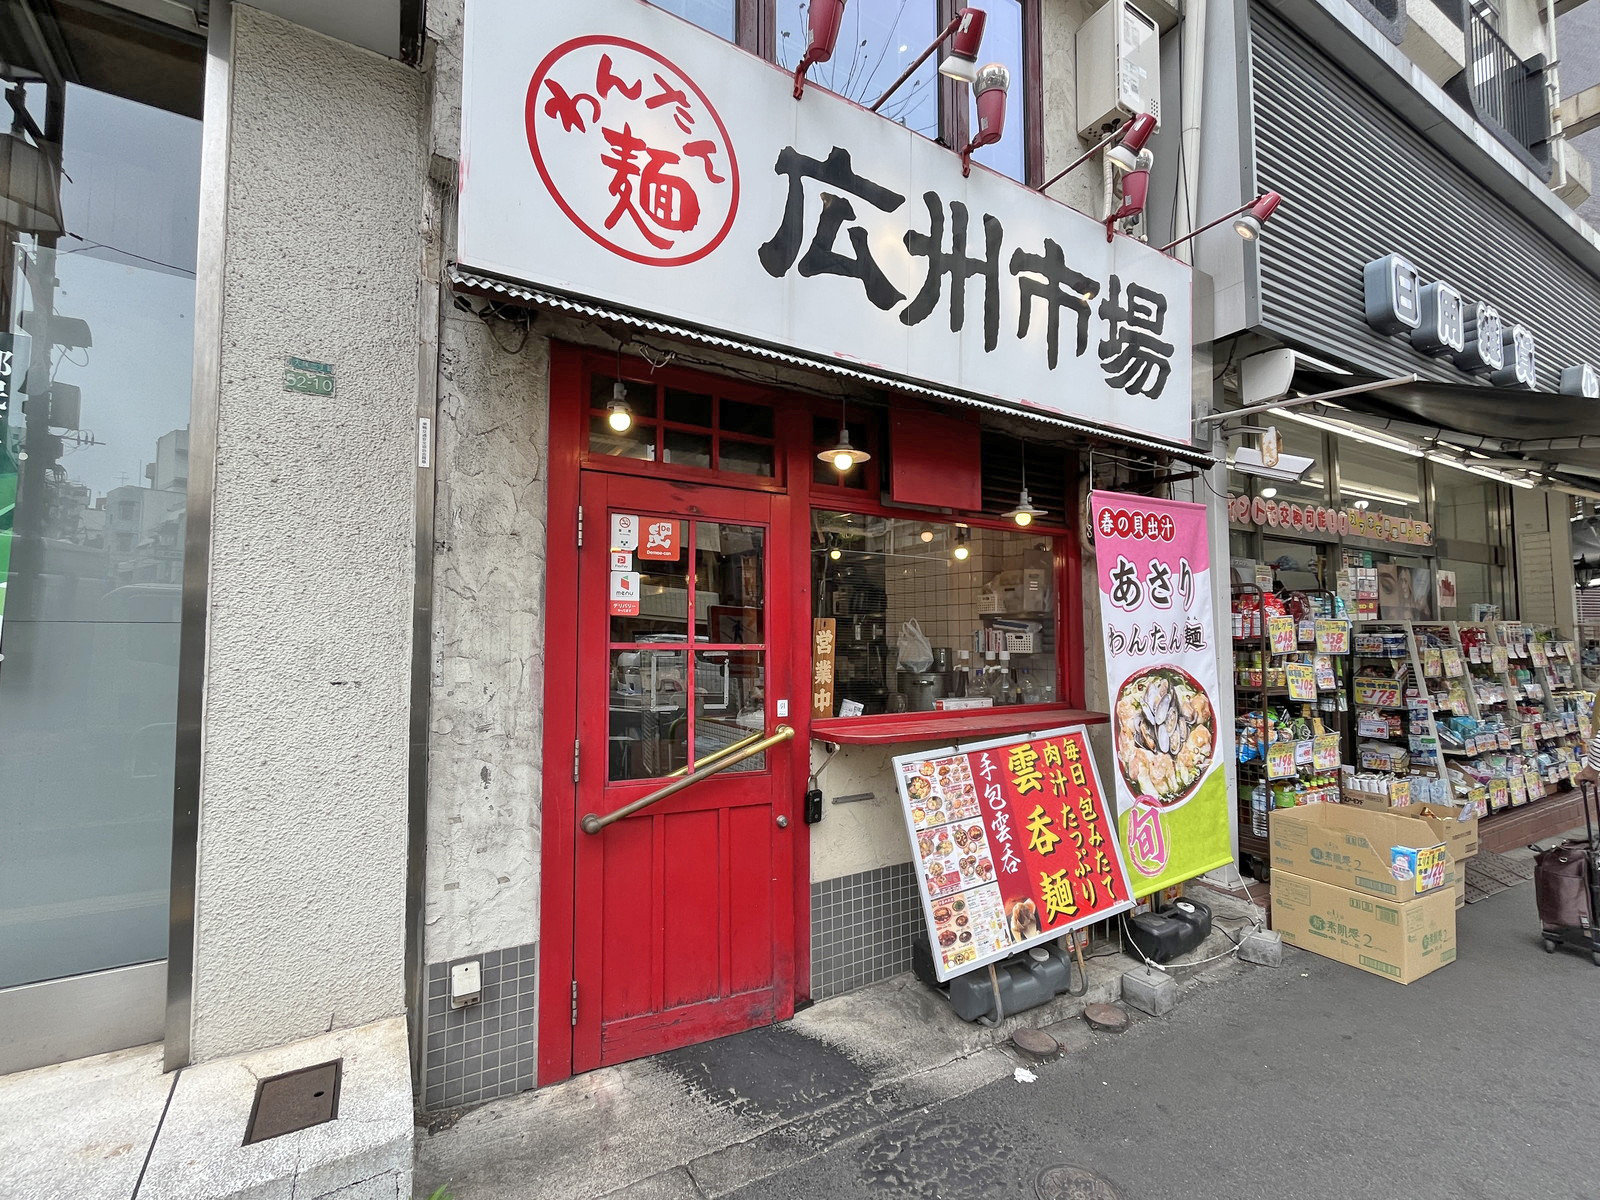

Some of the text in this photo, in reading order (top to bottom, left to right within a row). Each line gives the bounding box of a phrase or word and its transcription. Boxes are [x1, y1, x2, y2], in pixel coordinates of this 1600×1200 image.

[600, 121, 701, 250] 麺
[757, 145, 1175, 400] 広州市場
[286, 373, 333, 392] 52-10
[1100, 511, 1173, 539] 春の貝出汁
[1112, 559, 1192, 608] あさり
[814, 630, 833, 712] 営業中
[1109, 624, 1206, 656] わんたん麺
[1008, 744, 1079, 924] 雲呑麺
[1063, 738, 1116, 899] 毎日、包みたて
[1130, 806, 1165, 865] 旬
